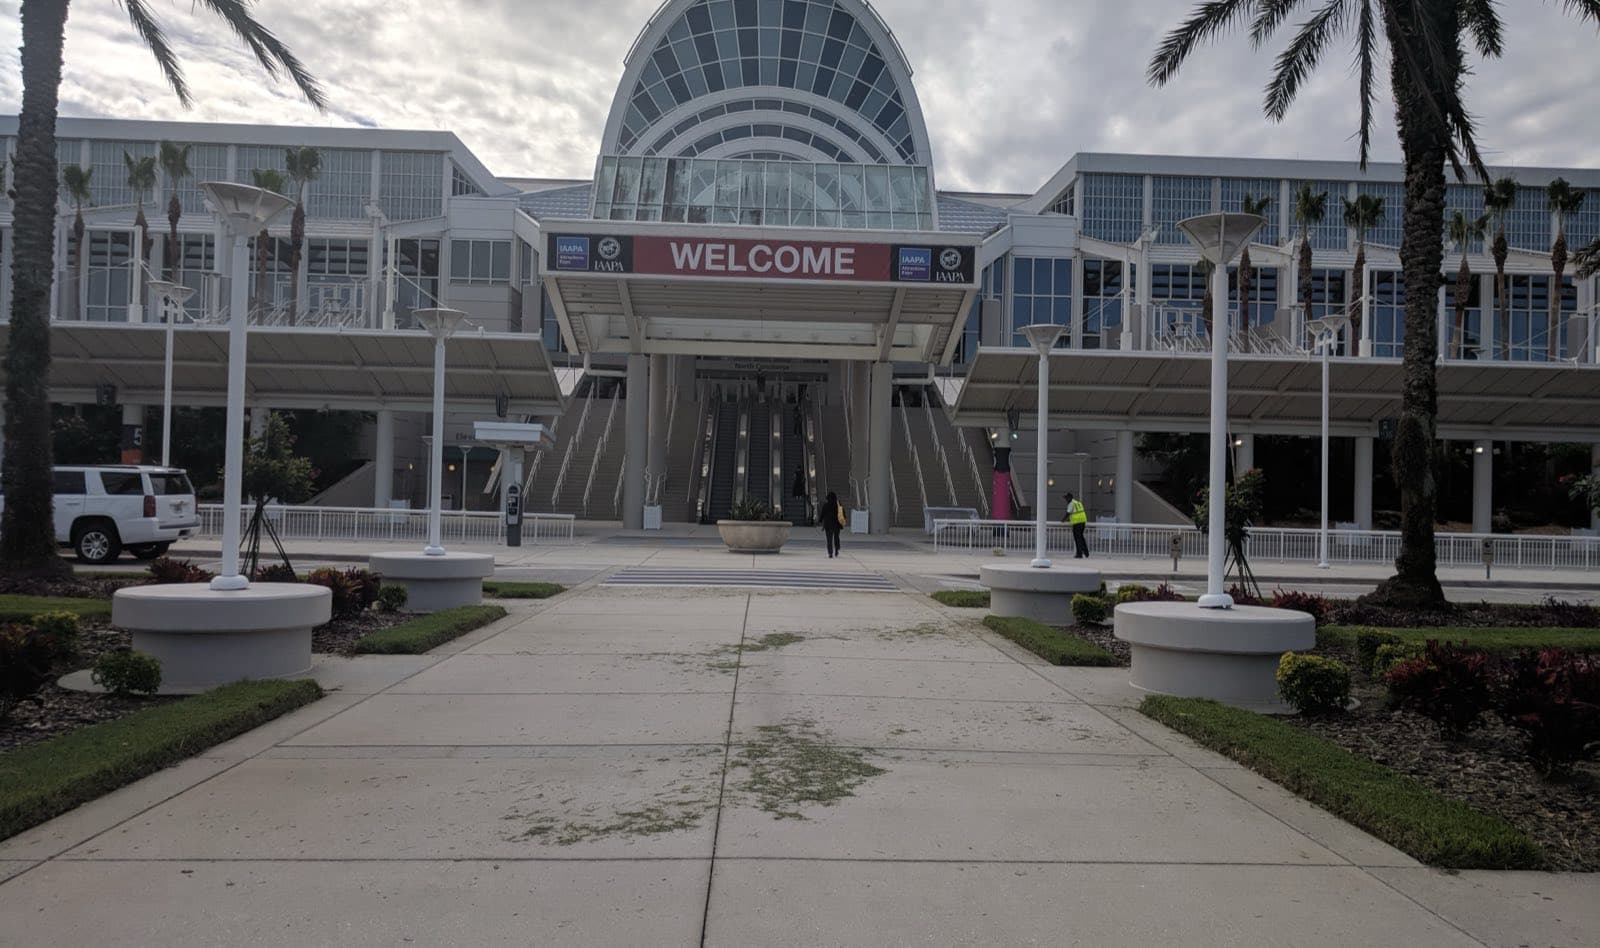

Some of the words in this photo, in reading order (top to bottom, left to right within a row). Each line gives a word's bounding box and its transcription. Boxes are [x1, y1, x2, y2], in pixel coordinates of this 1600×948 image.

[670, 242, 855, 275] WELCOME
[902, 256, 925, 264] IAAPA
[594, 260, 624, 271] IAAPA
[936, 272, 965, 282] IAAPA
[133, 428, 143, 446] 5
